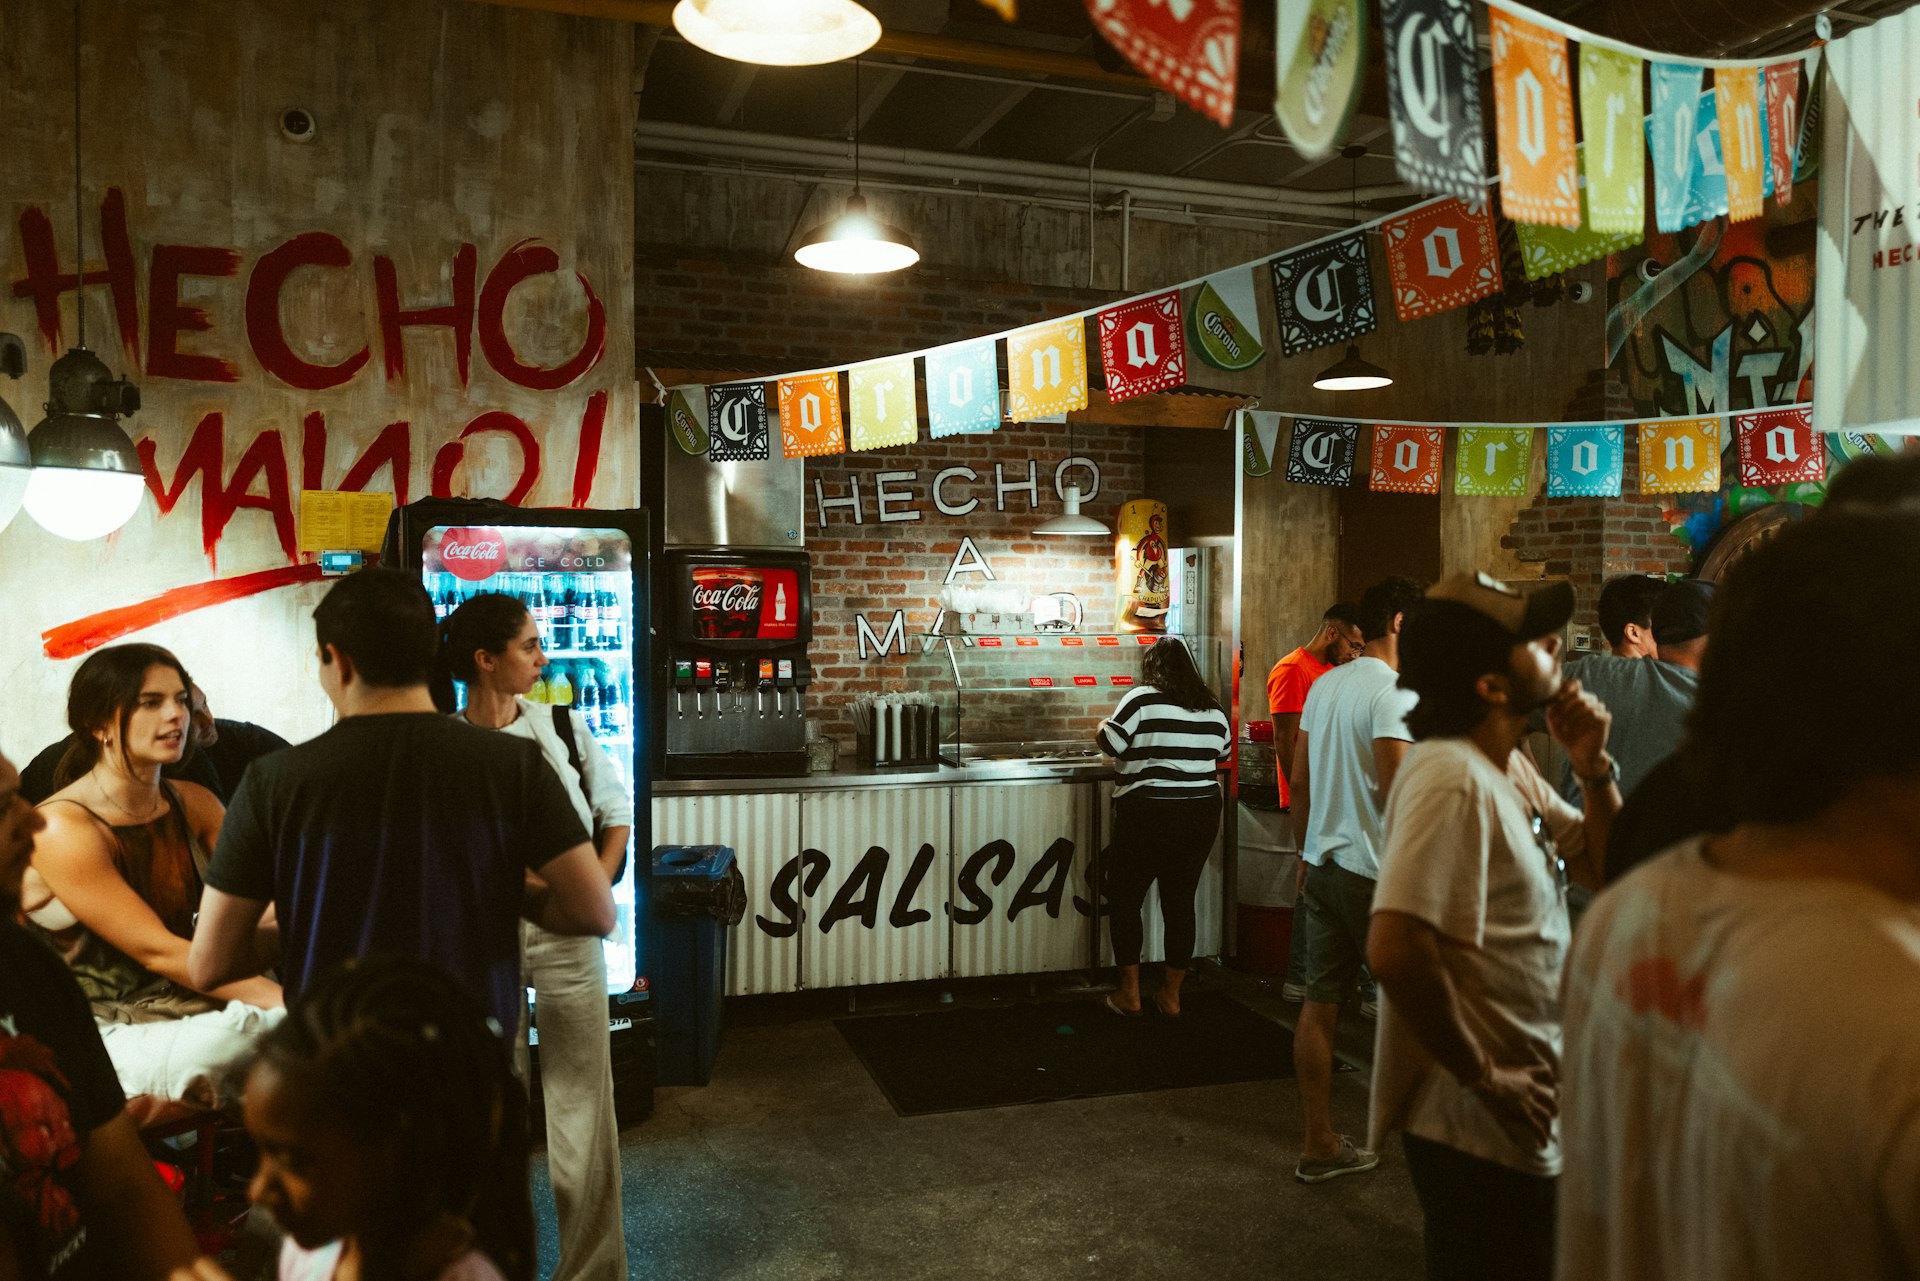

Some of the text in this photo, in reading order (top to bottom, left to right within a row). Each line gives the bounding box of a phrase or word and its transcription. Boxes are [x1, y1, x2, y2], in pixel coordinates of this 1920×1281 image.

[1853, 205, 1904, 235] THE
[1873, 243, 1920, 270] HEC
[13, 186, 607, 391] HECHO
[1203, 311, 1241, 360] Corona
[675, 410, 697, 447] Corona
[813, 456, 1100, 528] HECHO
[443, 541, 502, 560] Coca-Cola
[519, 557, 605, 567] ICE COLD
[943, 536, 996, 585] A
[693, 584, 761, 611] Coca-Cola
